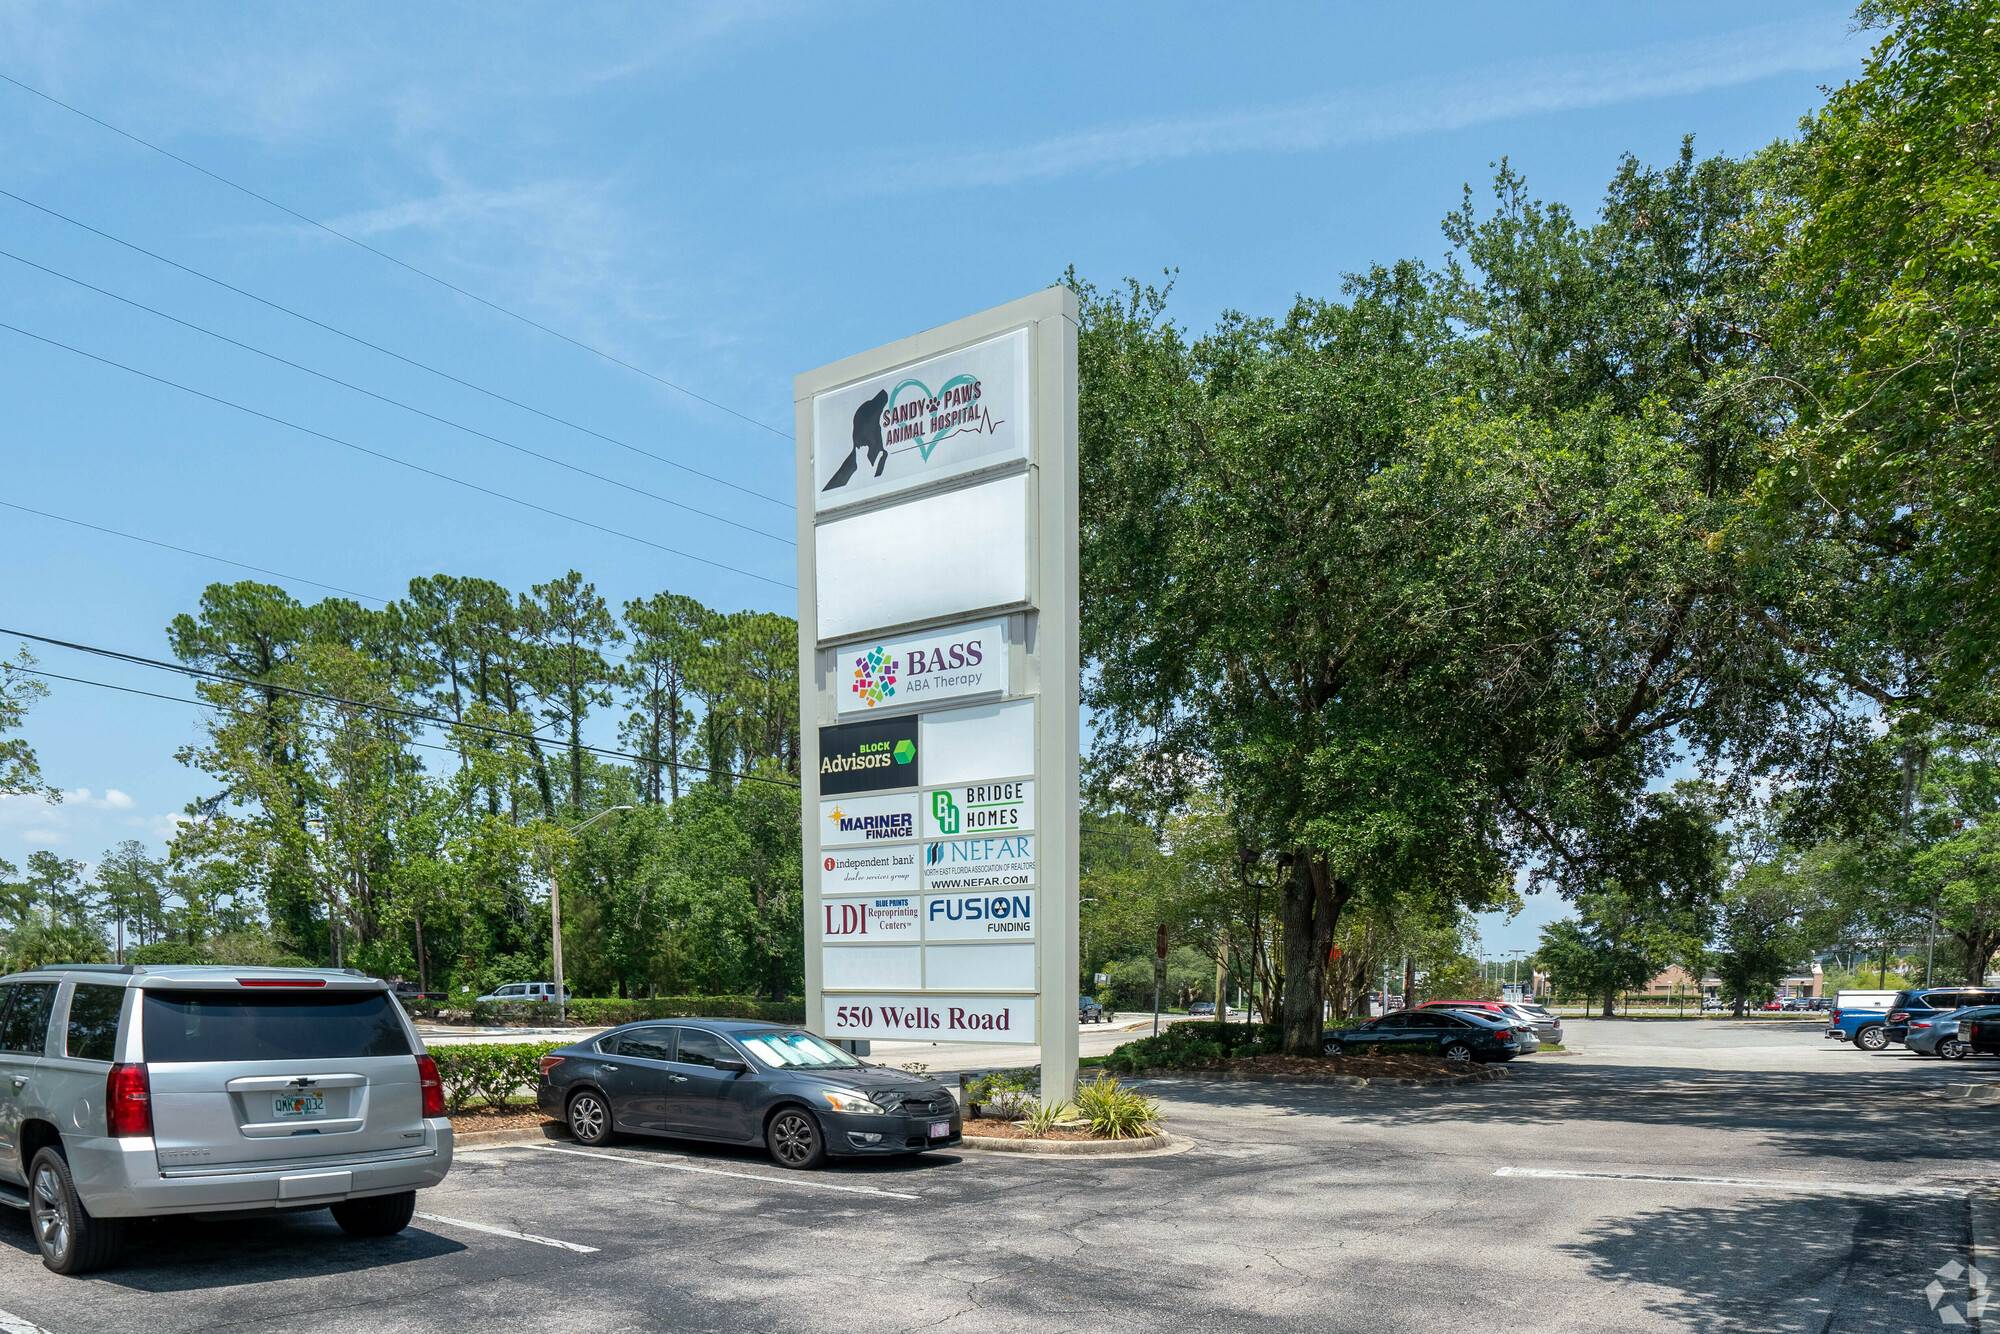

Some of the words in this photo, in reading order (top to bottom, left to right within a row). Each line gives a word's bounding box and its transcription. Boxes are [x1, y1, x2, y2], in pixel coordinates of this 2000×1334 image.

[882, 398, 926, 428] SANDY
[944, 381, 982, 410] PAWS
[886, 421, 926, 446] ANIMAL
[930, 404, 982, 434] HOSPITAL
[906, 640, 983, 676] BASS
[906, 679, 930, 693] ABA
[934, 673, 982, 688] Therapy
[860, 741, 890, 753] BLOCK
[820, 752, 892, 774] Advisors
[967, 783, 1023, 803] BRIDGE
[840, 813, 912, 831] MARINER
[967, 808, 1018, 828] HOMES
[866, 827, 913, 840] FINANCE
[951, 837, 1031, 862] NEFAR
[836, 856, 889, 870] independent
[892, 854, 914, 867] bank
[940, 867, 951, 876] EAST
[952, 865, 972, 875] FLORIDA
[972, 864, 1003, 874] ASSOCIATION
[1004, 863, 1011, 871] OF
[890, 873, 910, 882] group
[931, 876, 1029, 889] WWW.NEFAR.COM
[868, 907, 918, 919] Reproprinting
[889, 899, 909, 907] PRINTS
[930, 896, 1030, 921] FUSION
[824, 904, 868, 935] LDI
[988, 922, 1030, 932] FUNDING
[837, 1006, 873, 1028] 550
[880, 1006, 940, 1029] Wells
[948, 1008, 1010, 1031] Road
